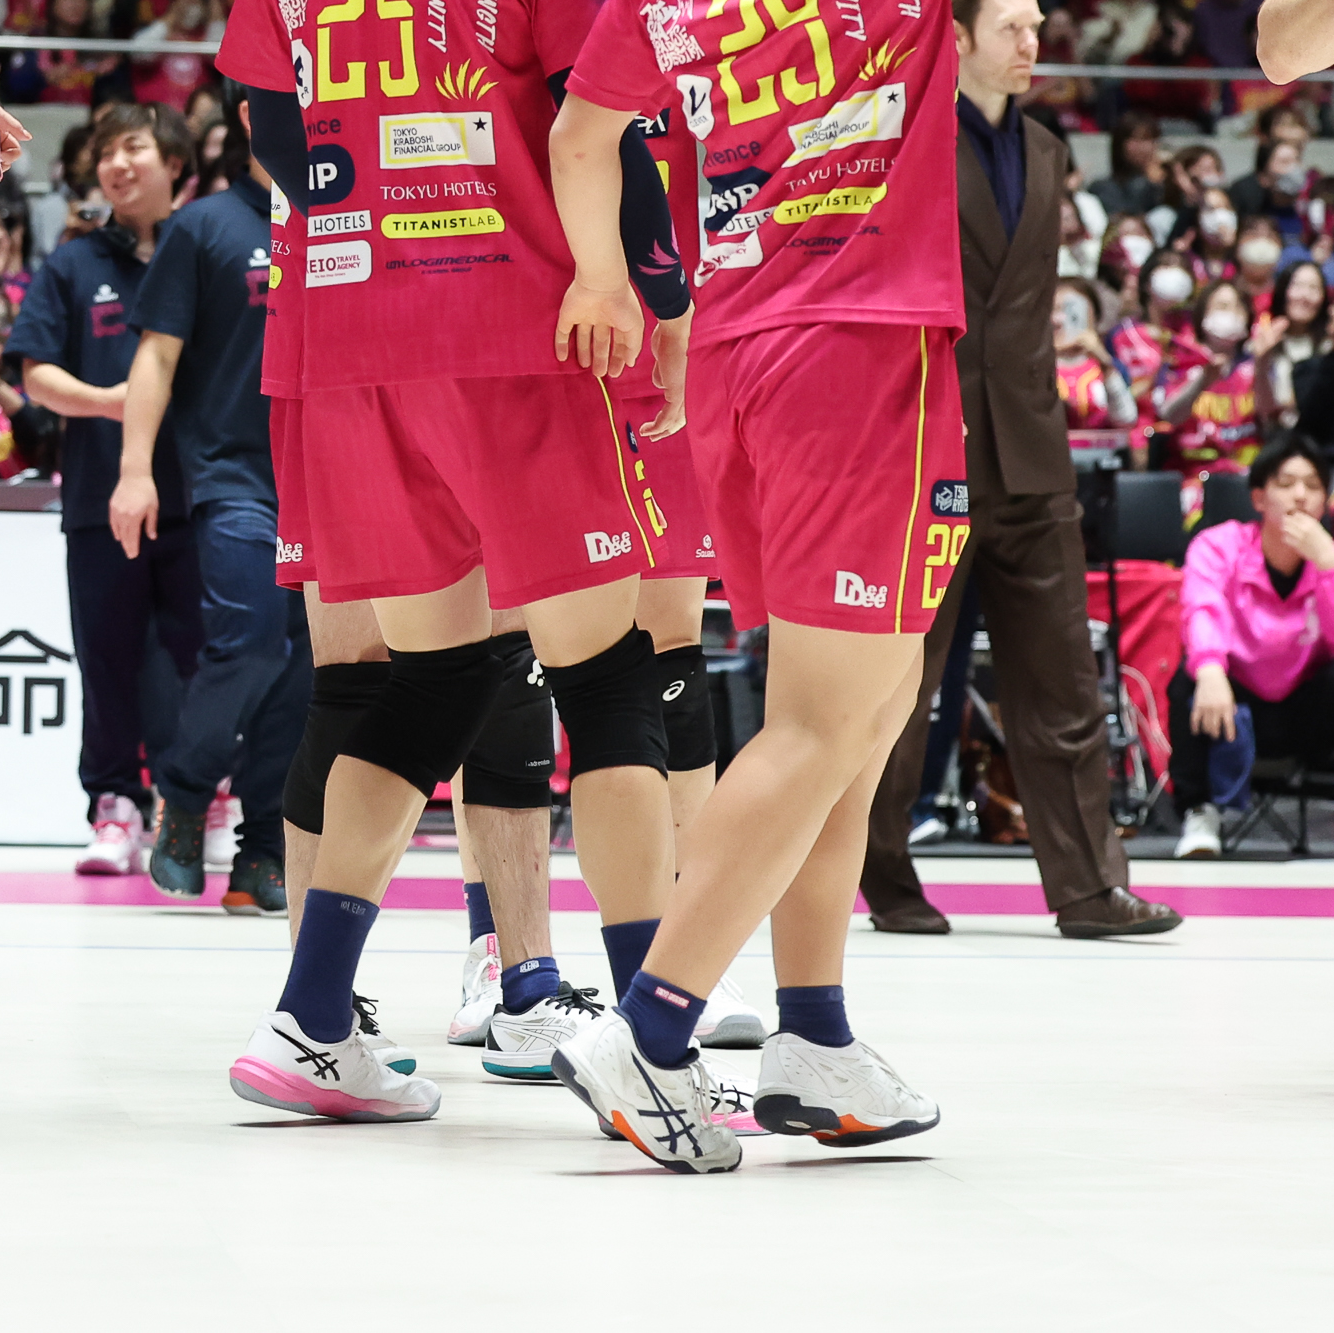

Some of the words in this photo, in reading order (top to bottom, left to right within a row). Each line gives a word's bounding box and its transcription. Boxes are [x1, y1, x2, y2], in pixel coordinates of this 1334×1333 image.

[393, 127, 417, 137] TOKYO
[393, 136, 434, 145] KIRABOSHI
[394, 144, 436, 155] FINANCIAL
[785, 166, 830, 192] TYU
[380, 184, 438, 200] TOKYU
[444, 181, 497, 197] HOTELS
[785, 195, 873, 216] TITAISTLA
[314, 214, 366, 233] HOTELS
[721, 211, 770, 233] OTELS
[271, 239, 290, 256] ELS
[337, 255, 360, 264] TRAVEL
[337, 261, 360, 270] AGENCY
